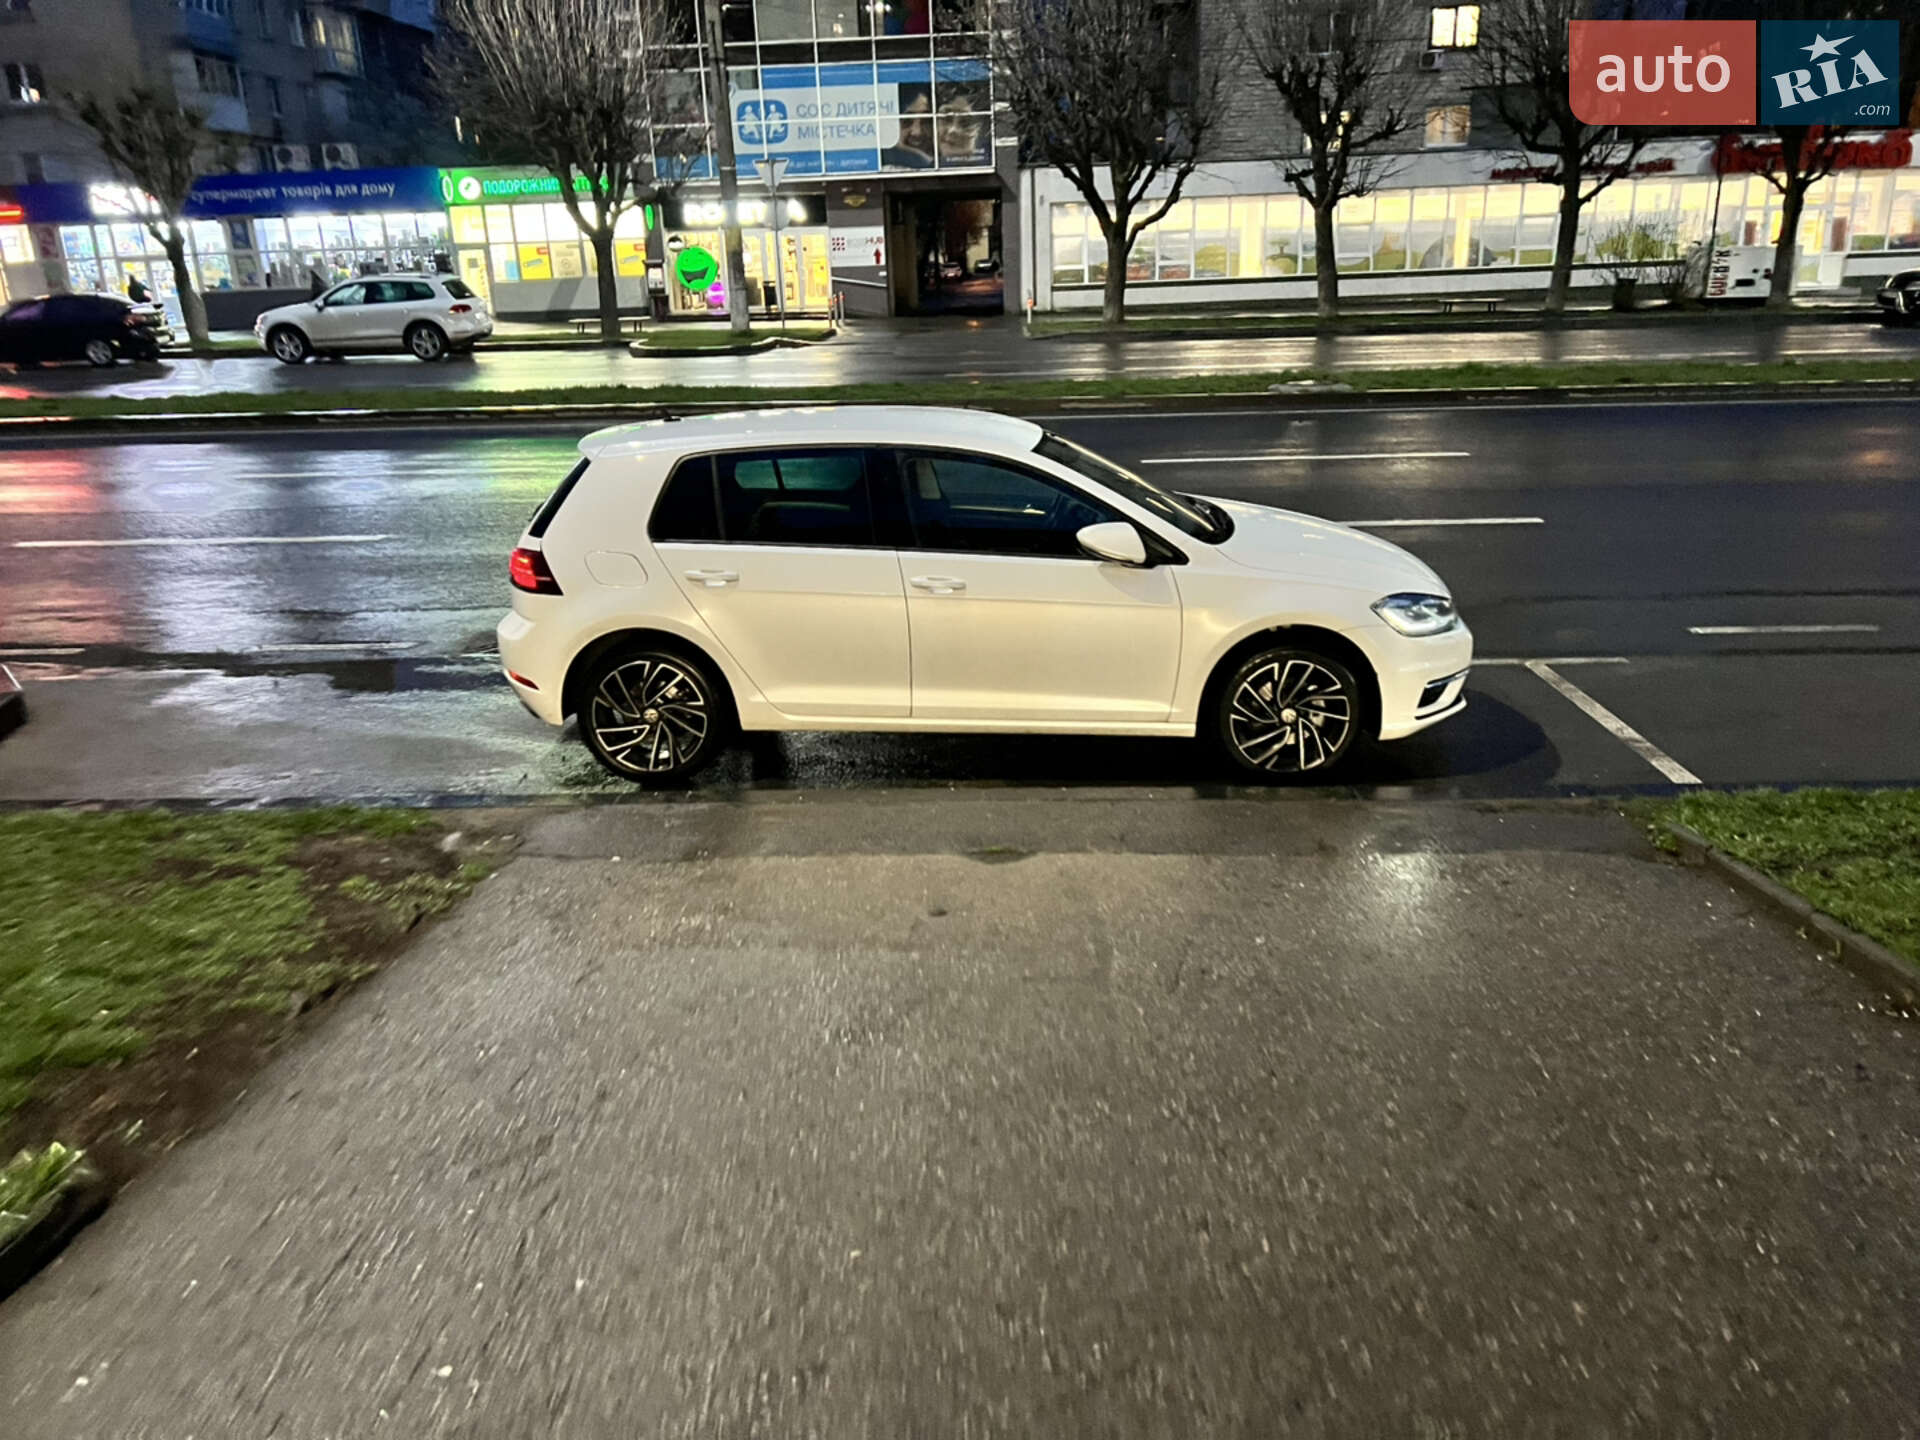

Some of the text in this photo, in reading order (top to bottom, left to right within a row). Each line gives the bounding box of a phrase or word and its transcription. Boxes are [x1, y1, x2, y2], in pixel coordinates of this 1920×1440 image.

[796, 100, 894, 118] СОС ДИТЯЧІ
[797, 123, 877, 139] МІСТЕЧКА
[281, 182, 332, 200] товарів
[335, 183, 358, 198] для
[361, 182, 395, 198] дому
[483, 177, 561, 195] ПОДОРОЖНИ
